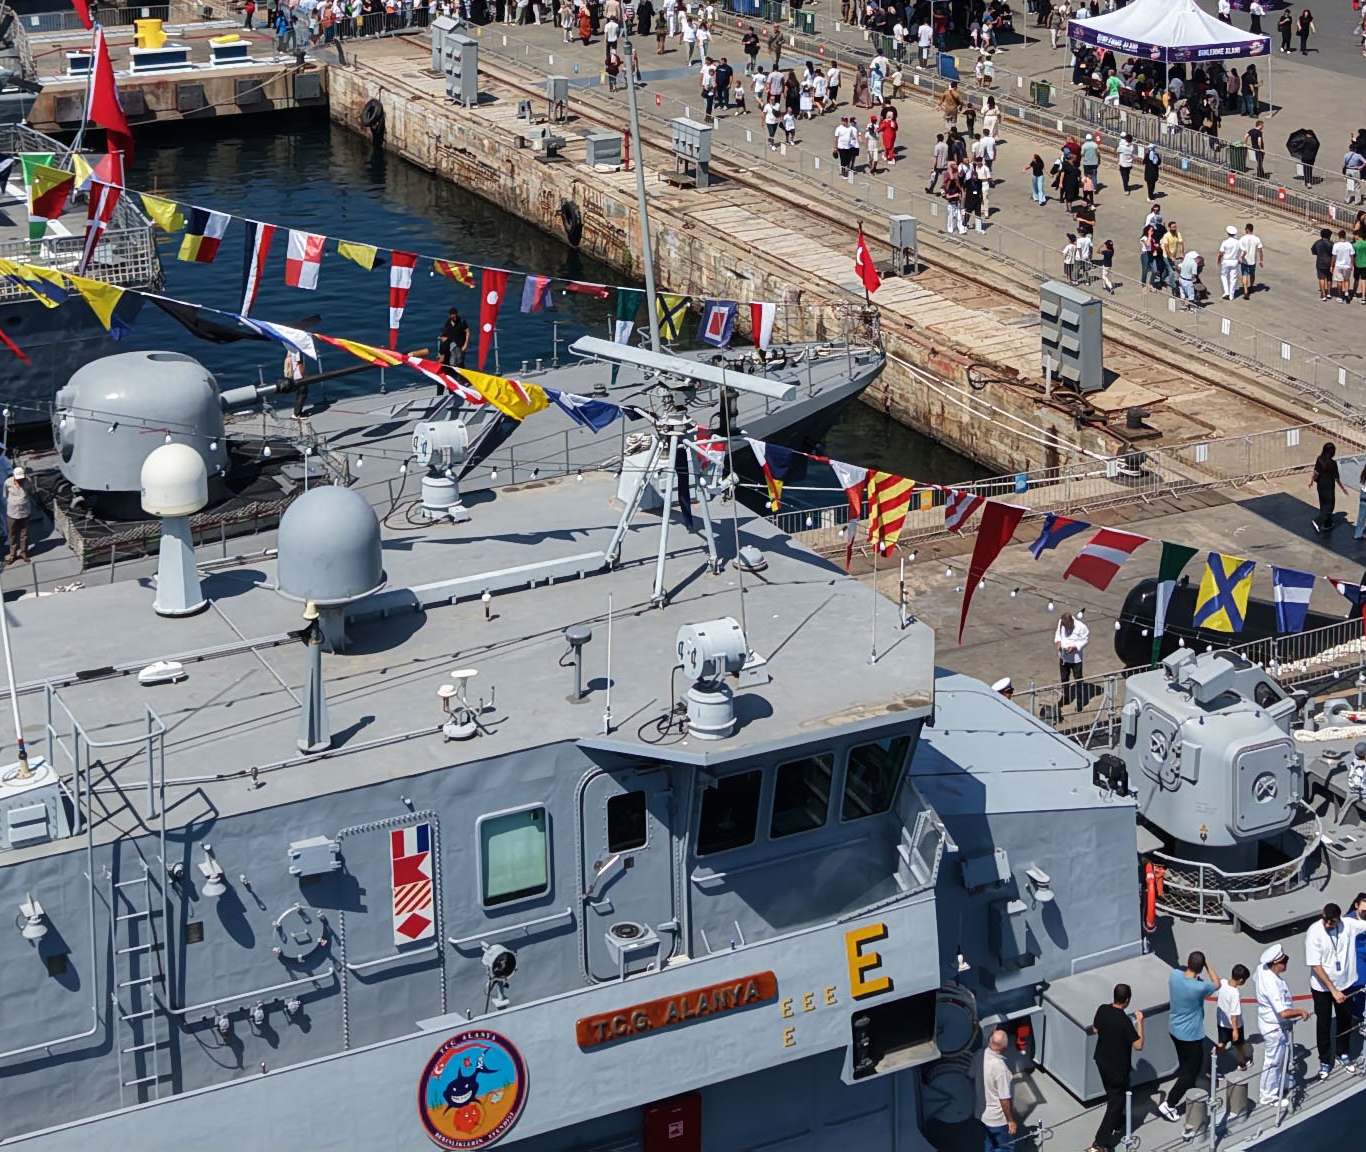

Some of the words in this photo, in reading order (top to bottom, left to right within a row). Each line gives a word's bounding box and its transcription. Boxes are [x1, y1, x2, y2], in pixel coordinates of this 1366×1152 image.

[845, 922, 894, 1001] E
[591, 1010, 652, 1042] T.C.G.
[665, 979, 761, 1025] ALANYA
